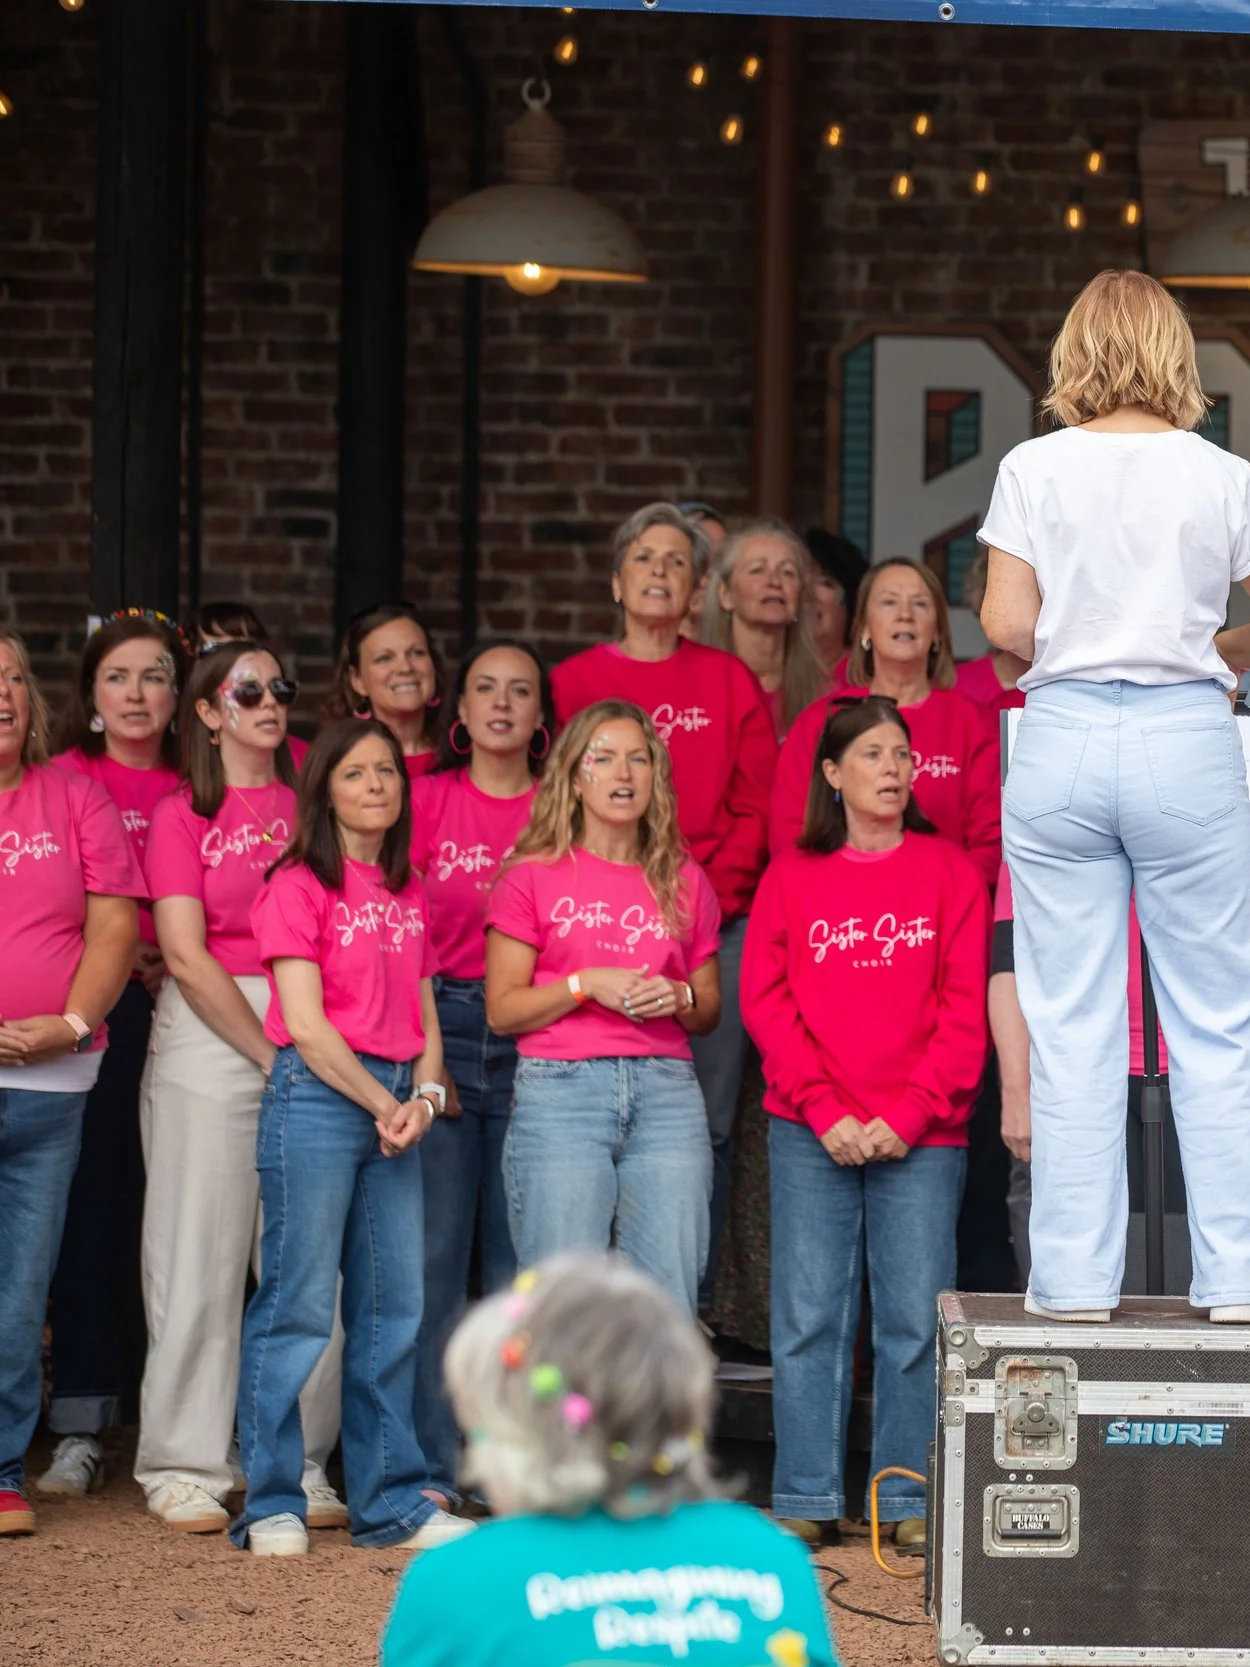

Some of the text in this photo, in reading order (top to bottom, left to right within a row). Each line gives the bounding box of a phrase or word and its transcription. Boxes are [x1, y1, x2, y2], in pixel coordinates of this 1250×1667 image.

[550, 896, 615, 938] Sister
[809, 912, 936, 963] Sister Sister
[596, 940, 635, 954] CHOIR
[853, 959, 892, 968] CHOIR
[1105, 1421, 1225, 1447] SHURE
[1012, 1513, 1050, 1522] BUFFALO
[1017, 1522, 1044, 1530] CASES
